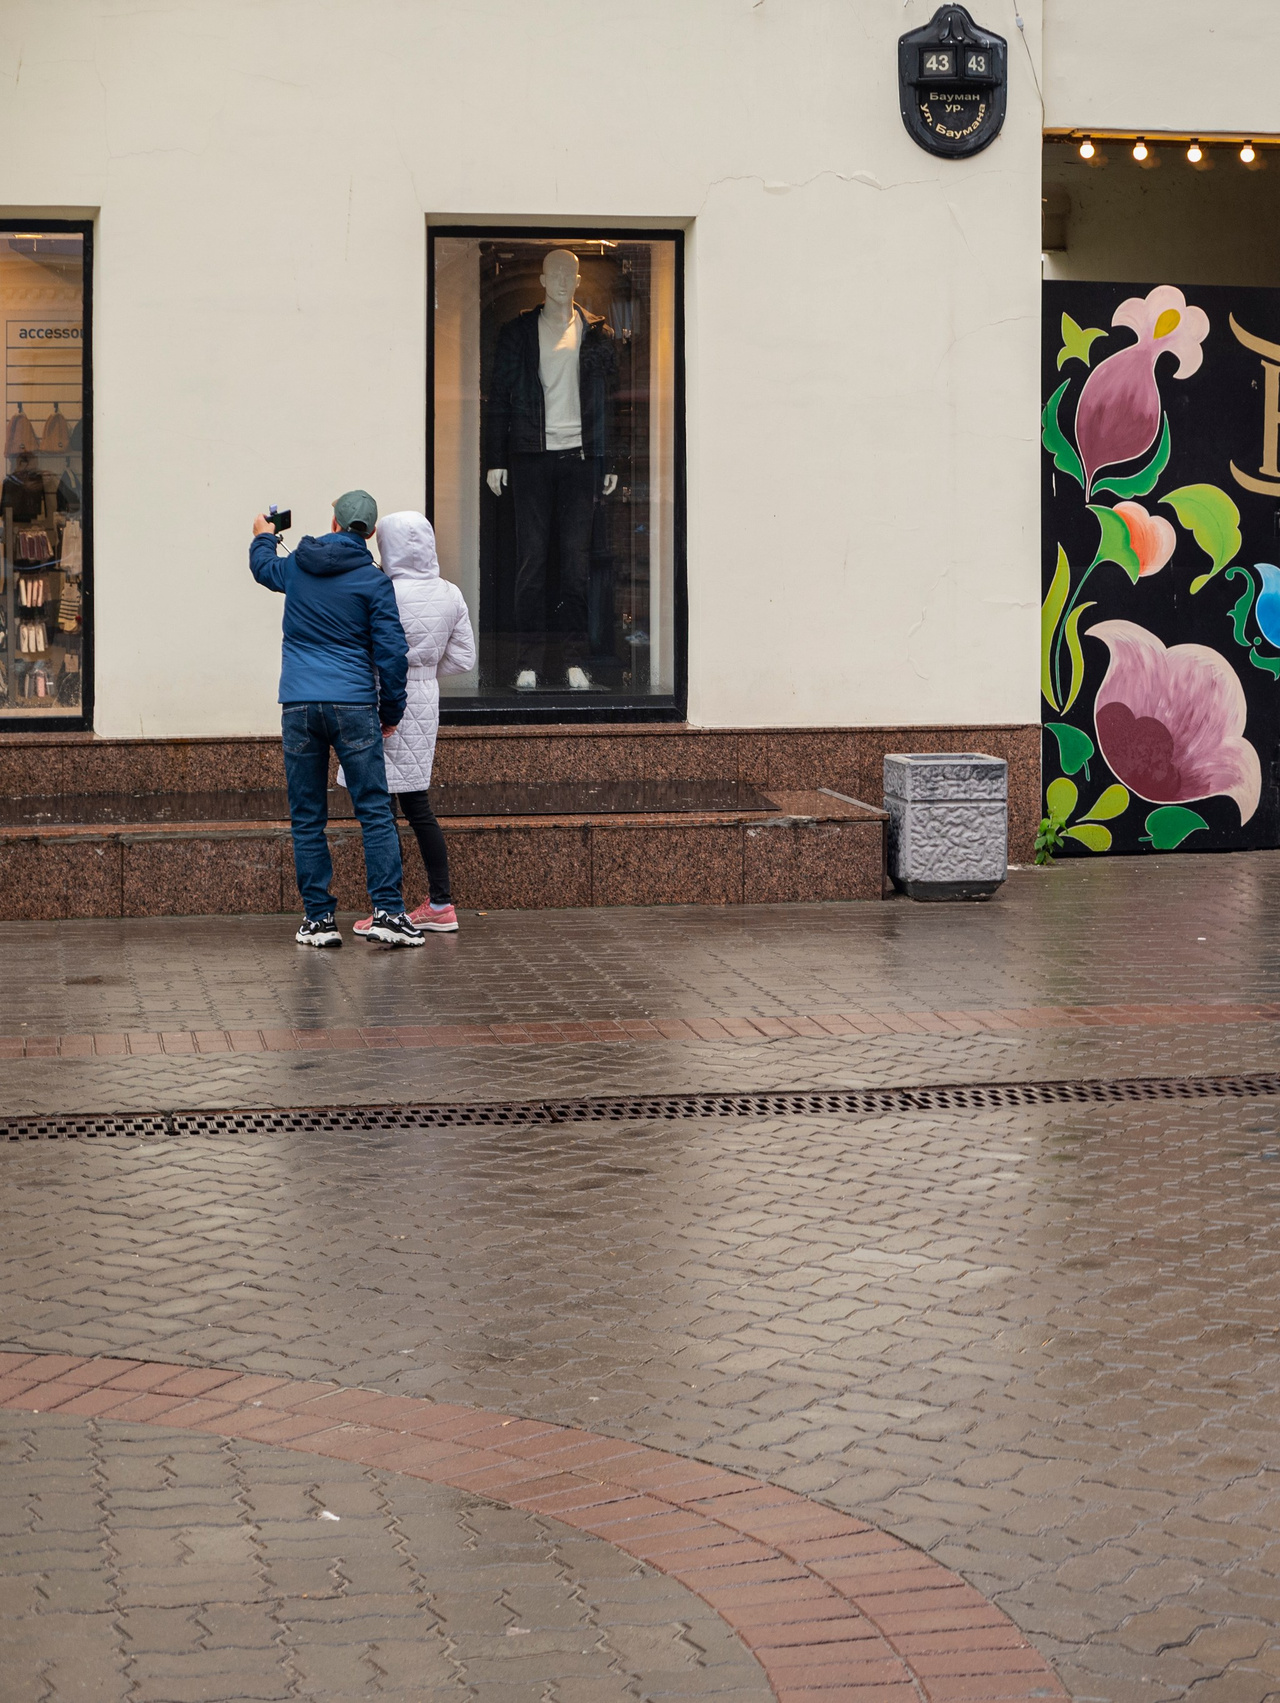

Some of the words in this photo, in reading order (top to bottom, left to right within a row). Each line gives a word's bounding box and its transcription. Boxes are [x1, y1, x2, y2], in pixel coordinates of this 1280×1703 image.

[926, 55, 949, 71] 43
[967, 55, 986, 72] 43
[929, 92, 980, 102] Бауман
[945, 104, 964, 113] ур.
[920, 103, 933, 126] ул.
[935, 103, 986, 139] Баумана
